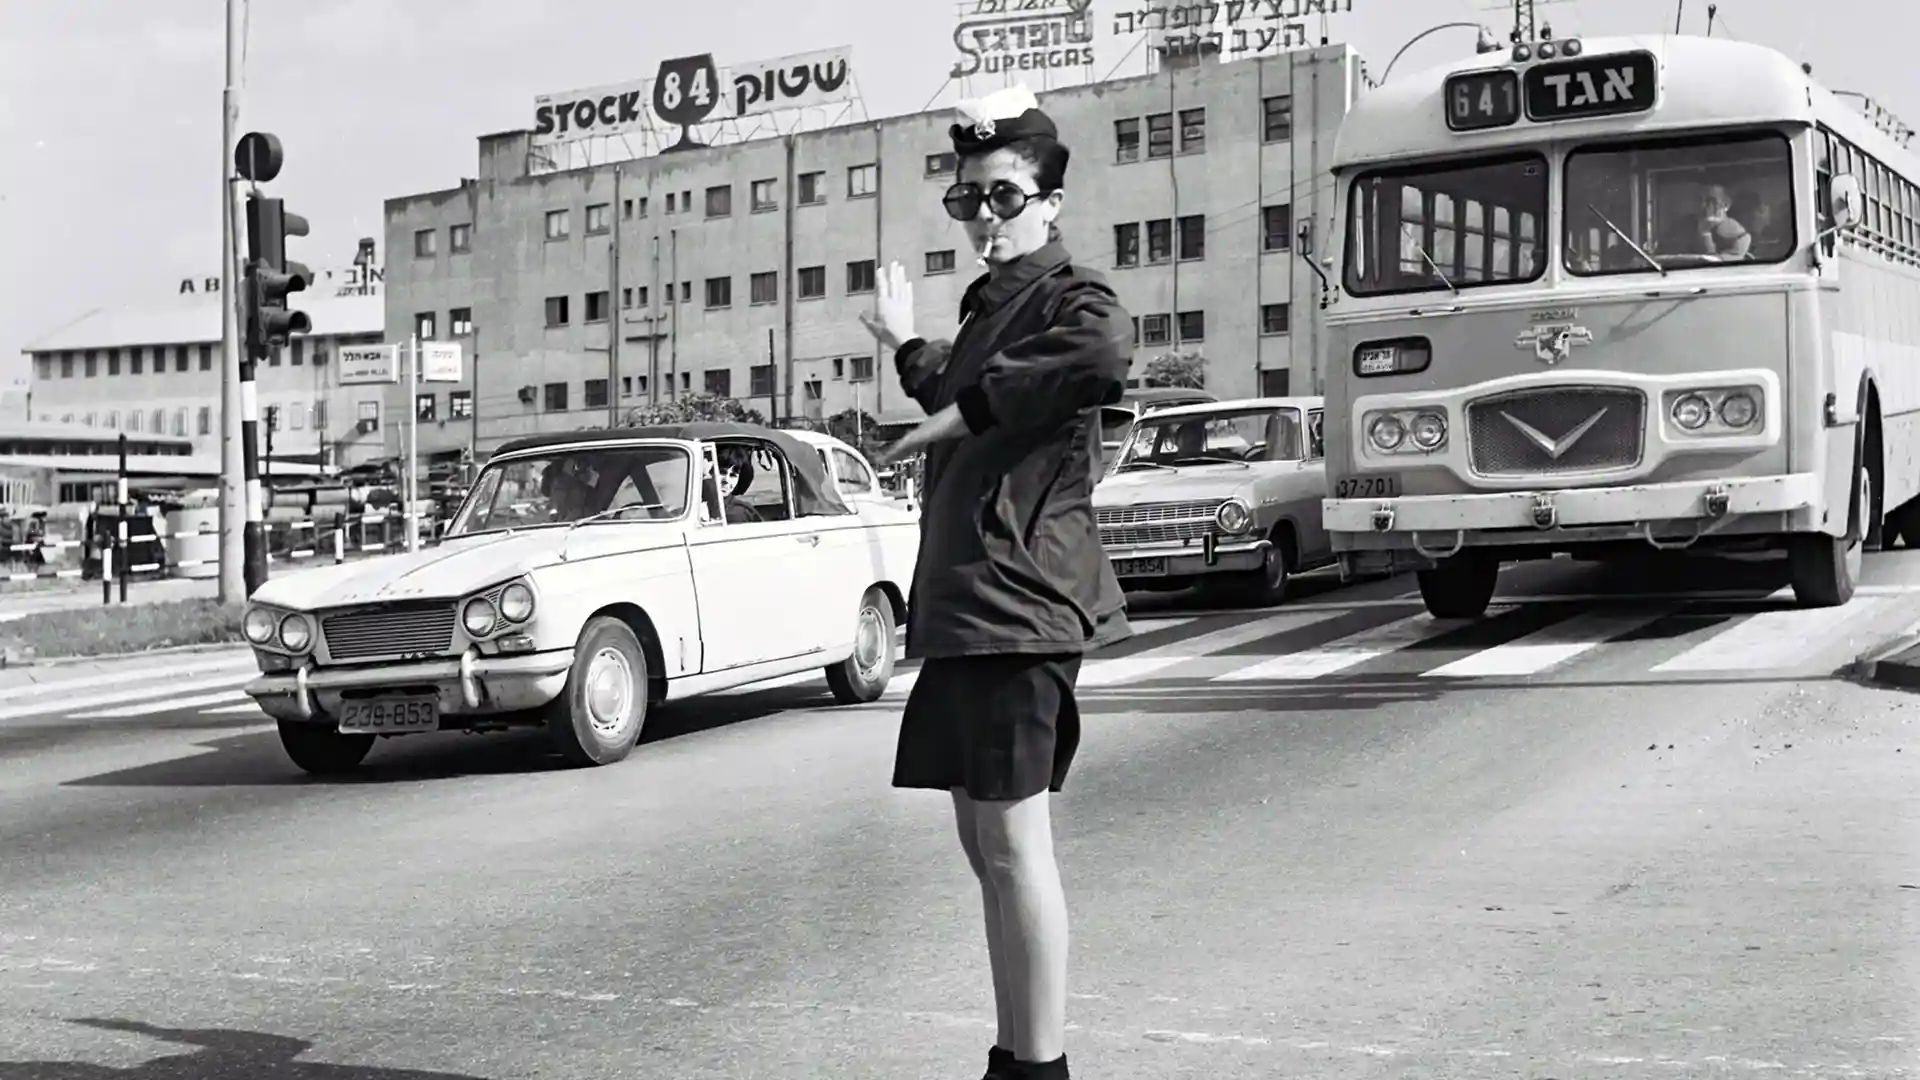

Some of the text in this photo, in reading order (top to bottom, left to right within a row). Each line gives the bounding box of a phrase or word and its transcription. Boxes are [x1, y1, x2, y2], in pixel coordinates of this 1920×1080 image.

[950, 24, 1095, 78] SUPERGAS
[535, 68, 711, 134] STOCK 84
[734, 58, 847, 115] שטוק
[1455, 80, 1514, 117] 641
[1544, 67, 1634, 107] אגד
[343, 702, 433, 726] 239-853
